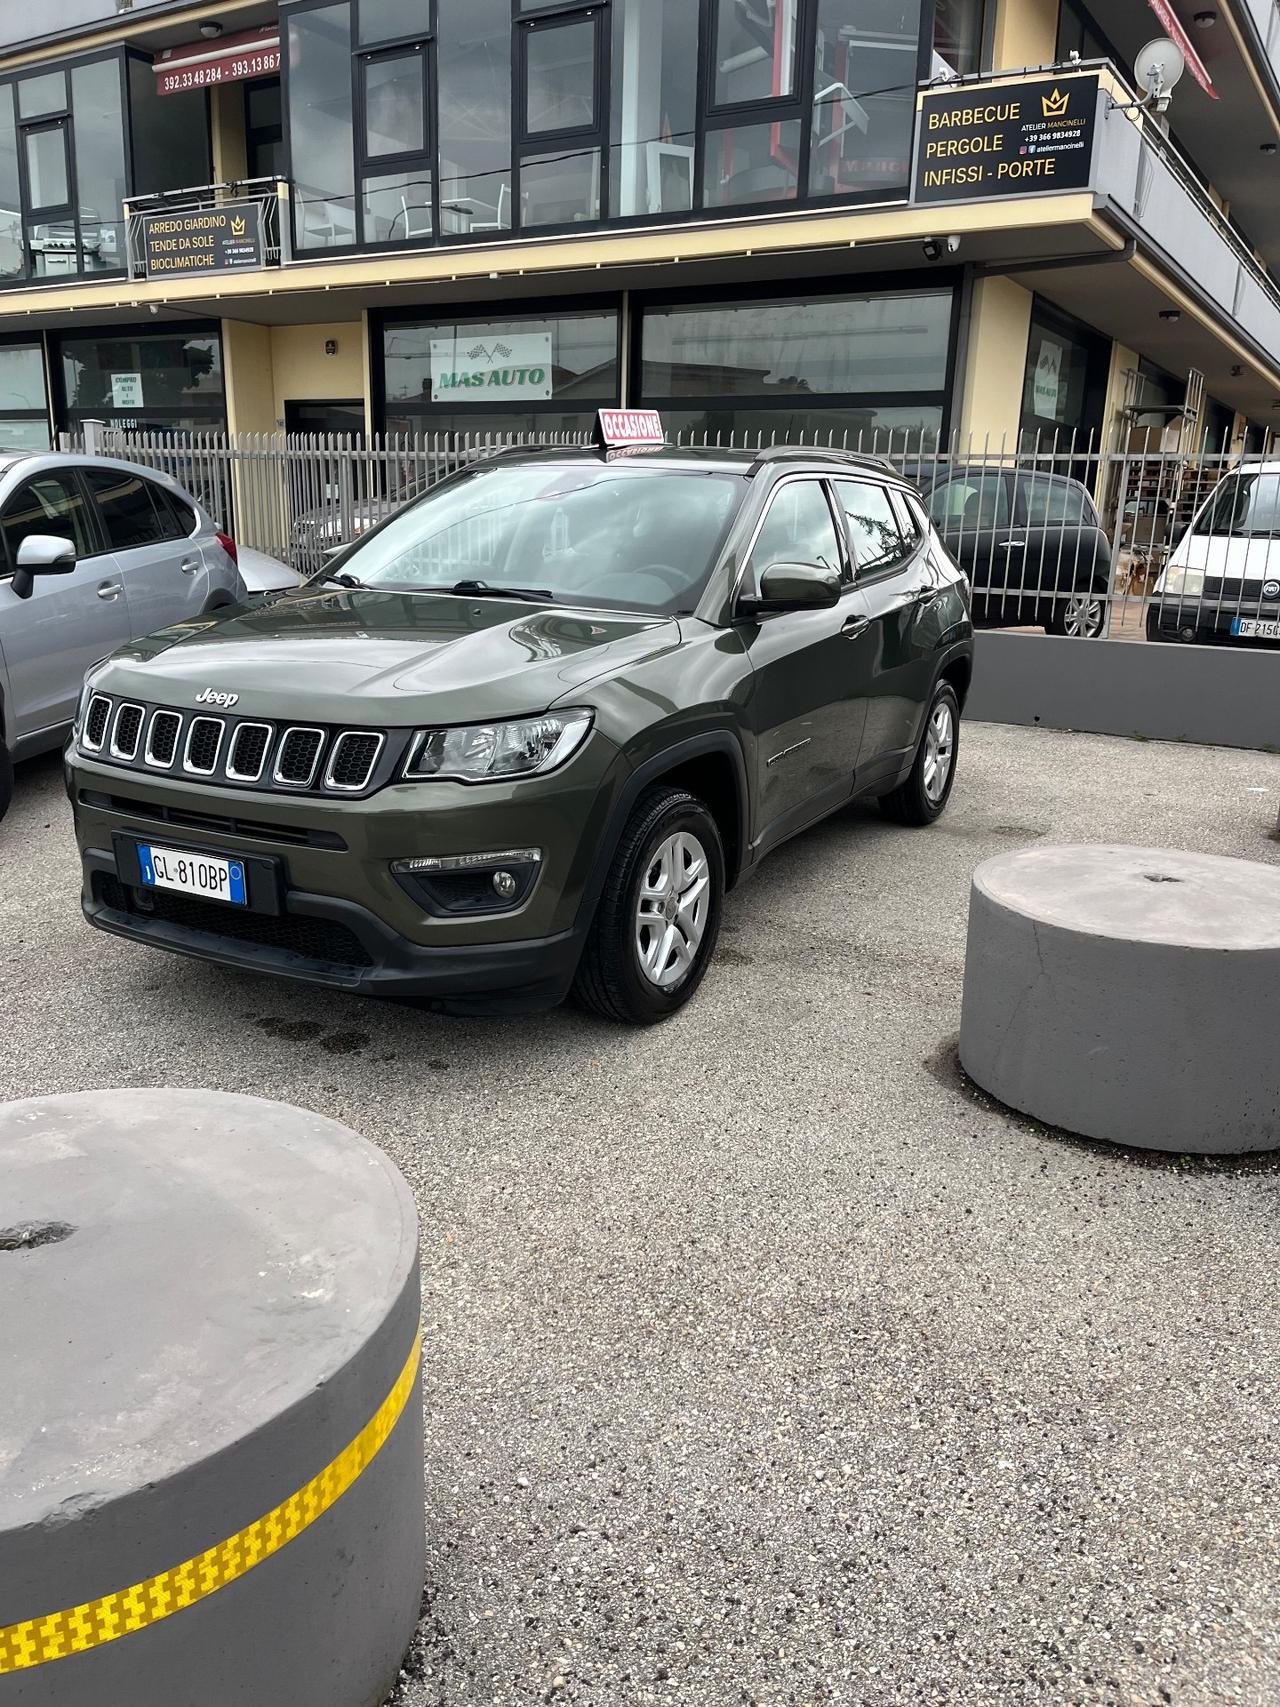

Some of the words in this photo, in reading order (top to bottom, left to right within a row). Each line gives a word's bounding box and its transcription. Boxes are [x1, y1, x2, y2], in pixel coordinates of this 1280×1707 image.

[928, 103, 1021, 130] BARBECUE
[1021, 122, 1046, 132] ATELIER
[1047, 118, 1086, 129] MANCINELLI
[1024, 134, 1038, 142] +39
[1038, 132, 1051, 141] 366
[1052, 129, 1081, 140] 9834928
[926, 134, 1004, 159] PERGOLE
[923, 165, 984, 187] INFISSI
[998, 158, 1056, 180] PORTE
[149, 220, 183, 235] ARREDO
[184, 215, 226, 230] GIARDINO
[149, 238, 178, 252] TENDE
[179, 237, 191, 250] DA
[192, 235, 215, 248] SOLE
[150, 254, 215, 271] BIOCLIMATICHE
[439, 371, 485, 389] MAS
[487, 368, 545, 387] AUTO
[110, 418, 137, 428] NOLEGGI
[603, 413, 662, 438] OCCASIONE
[195, 687, 239, 709] Jeep
